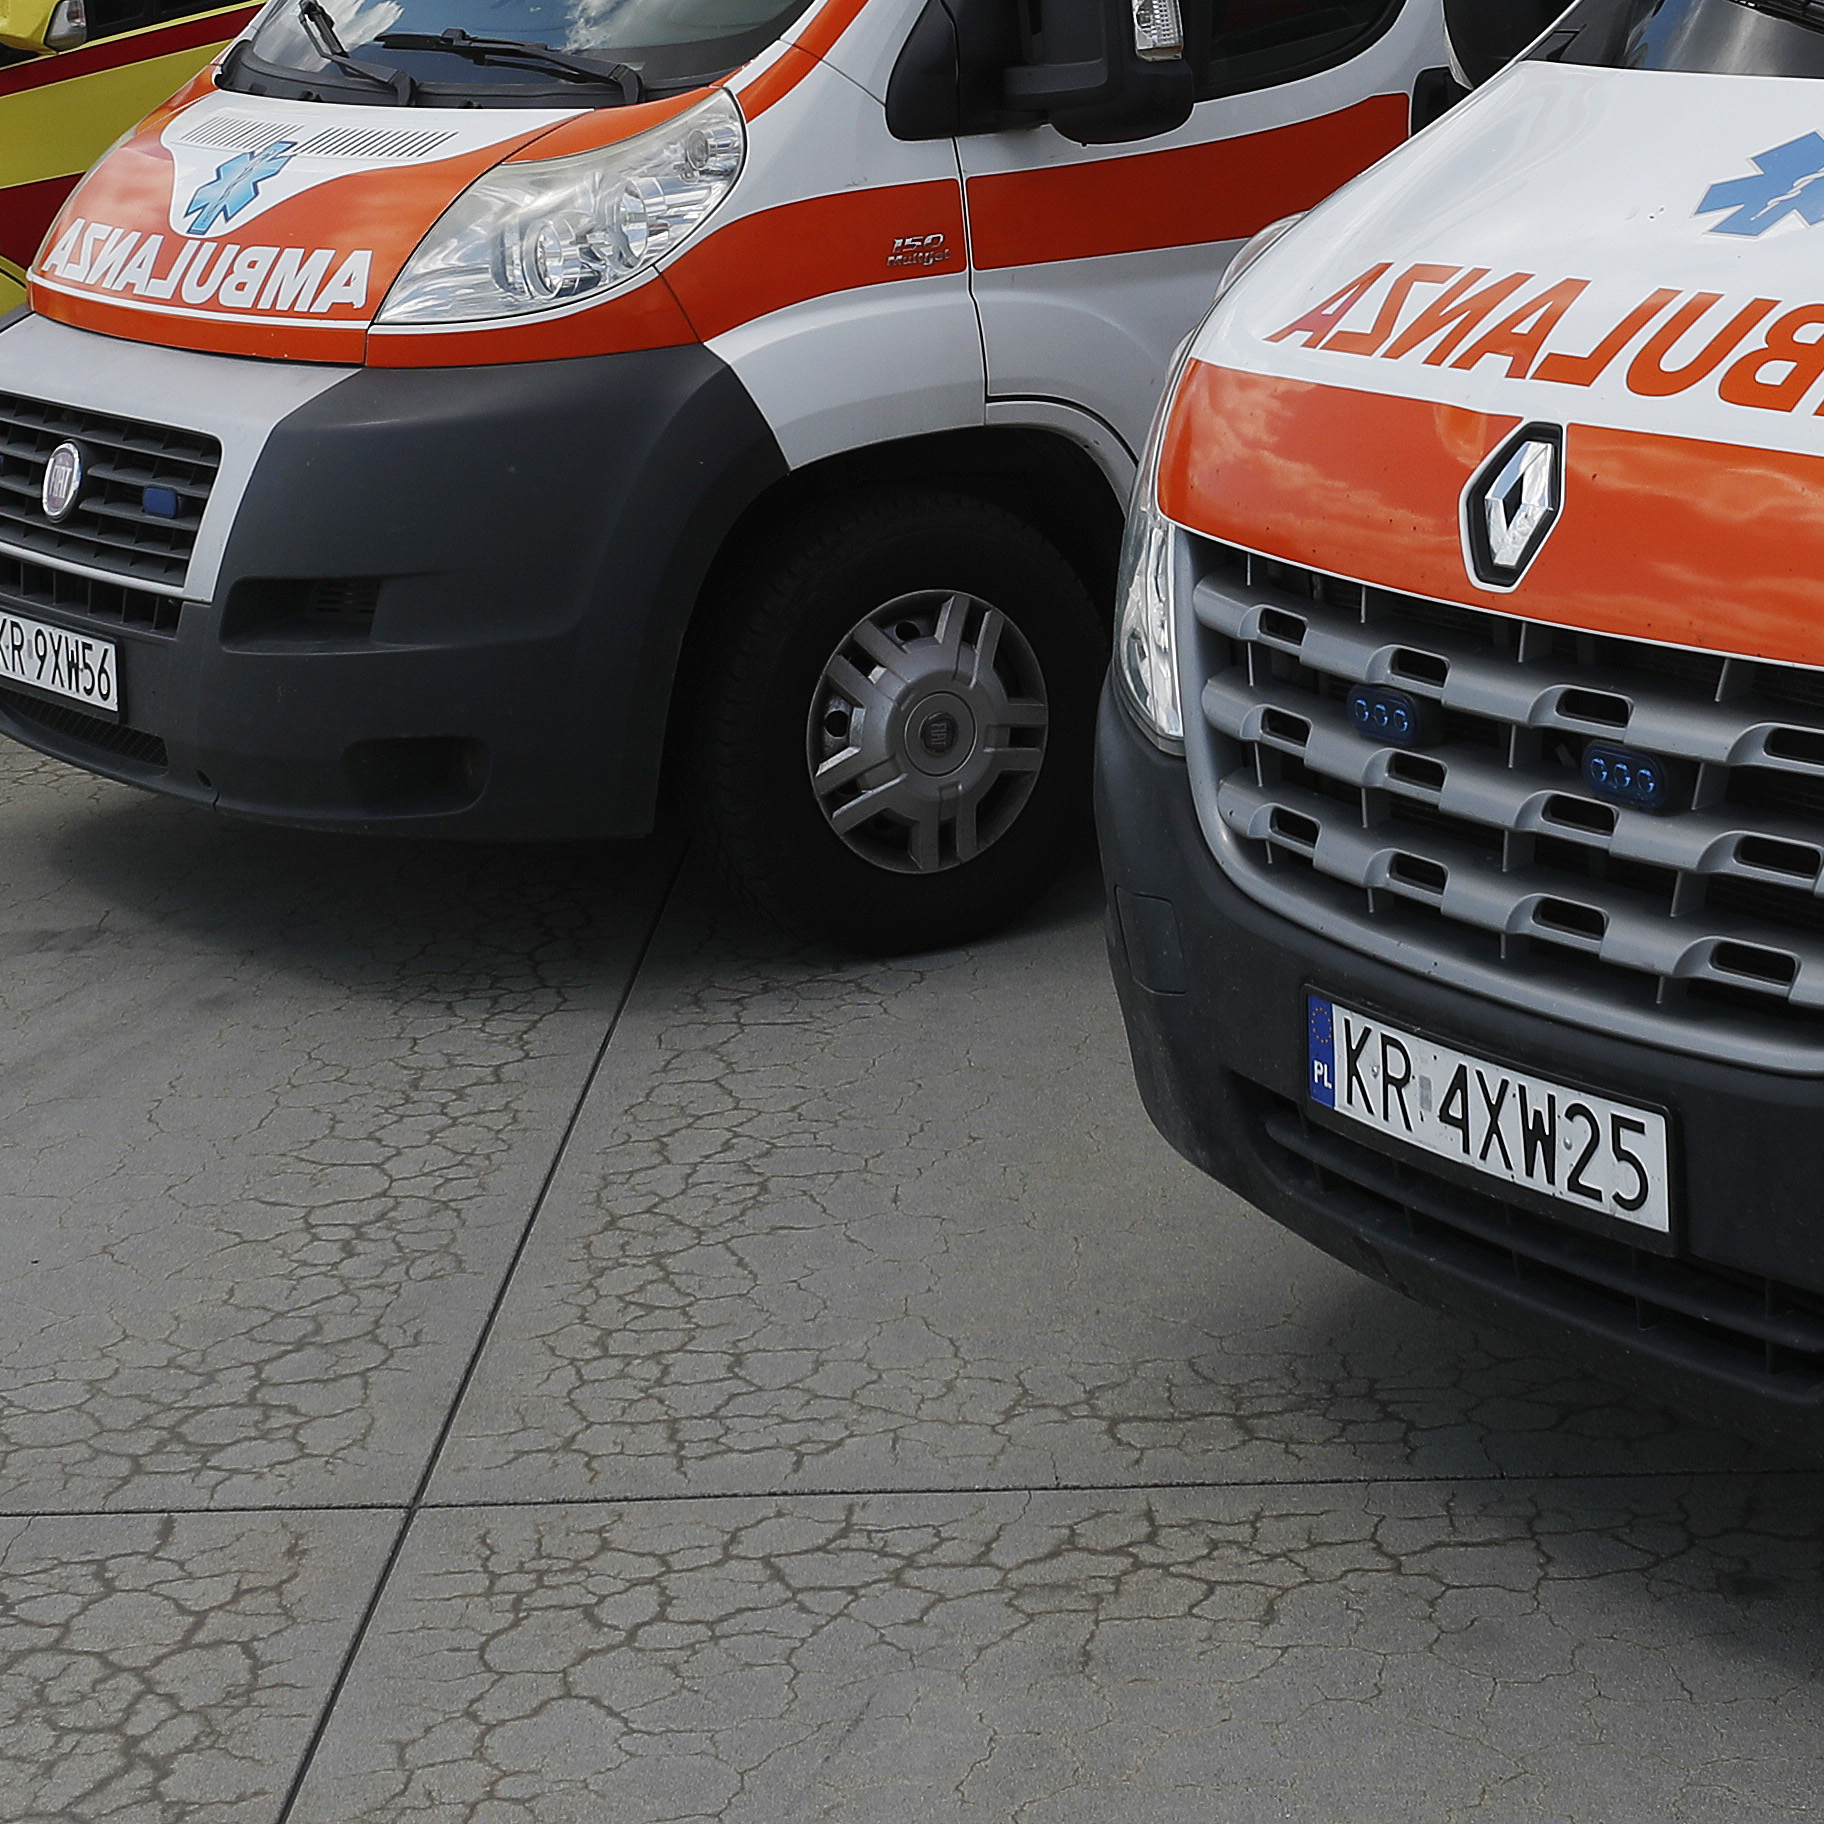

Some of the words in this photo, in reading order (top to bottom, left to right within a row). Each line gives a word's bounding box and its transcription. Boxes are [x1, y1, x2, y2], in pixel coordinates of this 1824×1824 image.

[887, 249, 950, 266] Multijet
[892, 234, 944, 253] 150
[49, 465, 72, 498] FIAT
[35, 628, 111, 701] 9XW56
[1313, 1059, 1332, 1089] PL
[1344, 1017, 1413, 1132] KR
[1439, 1063, 1649, 1211] 4XW25
